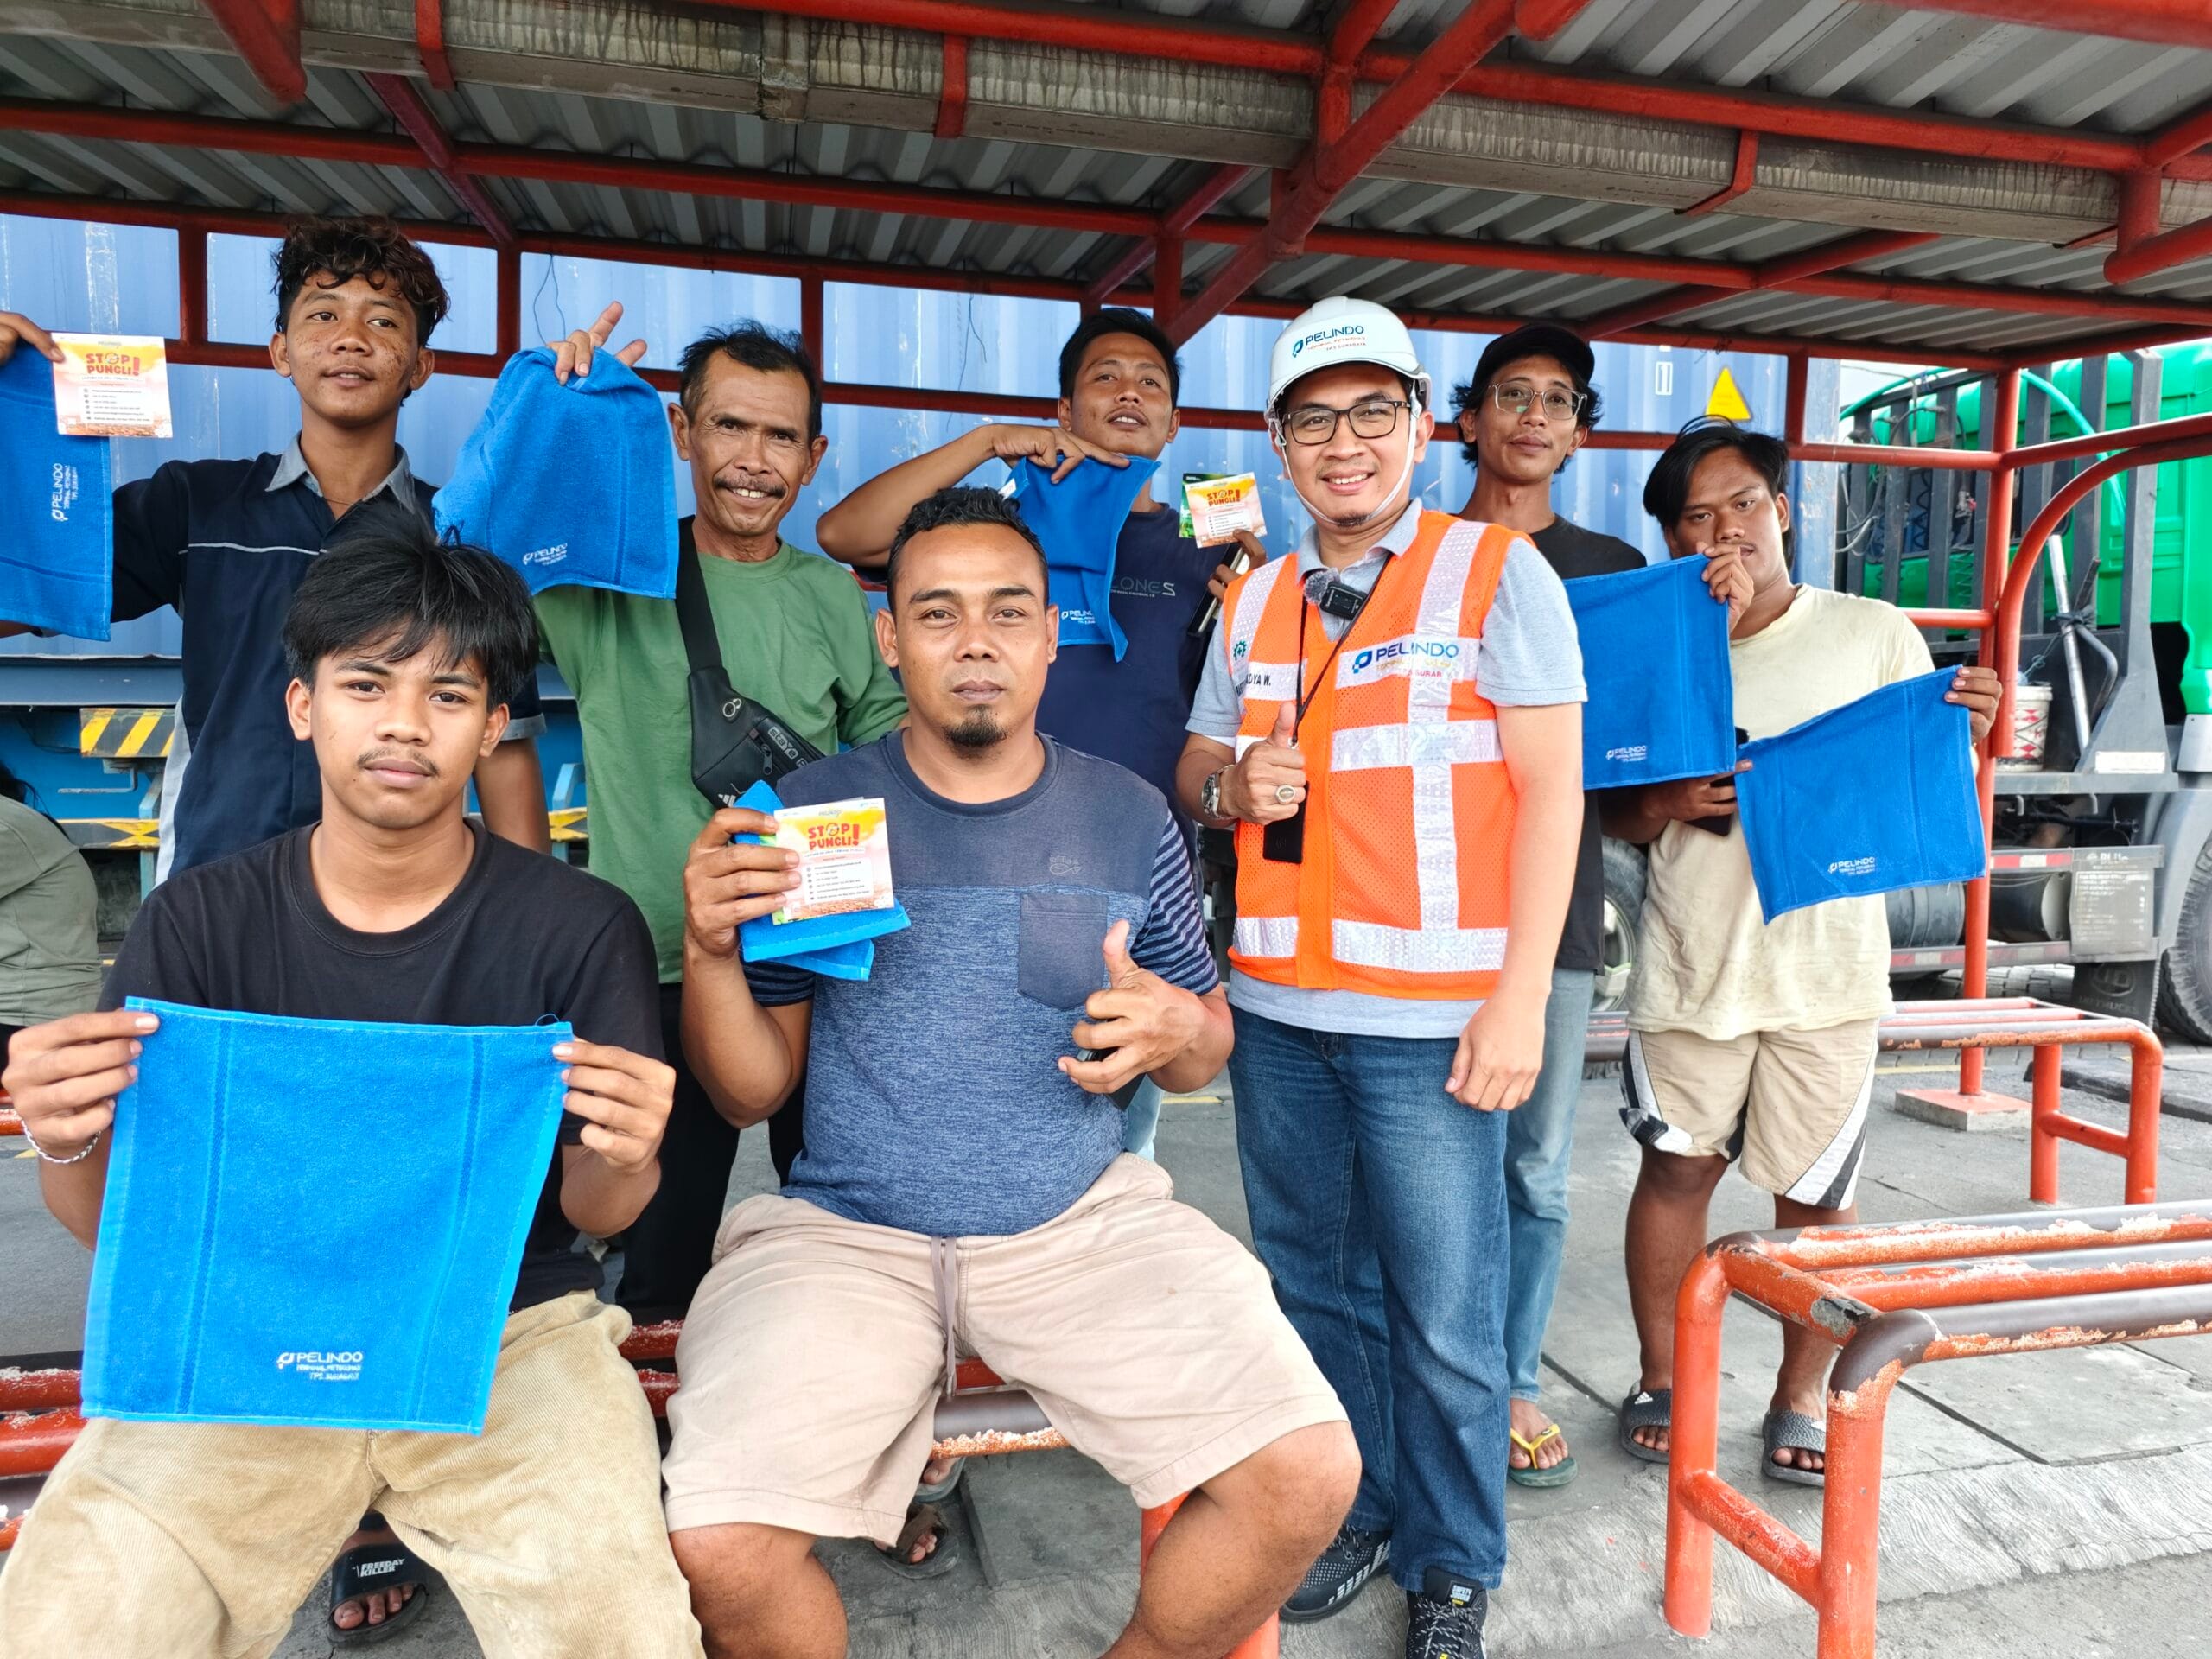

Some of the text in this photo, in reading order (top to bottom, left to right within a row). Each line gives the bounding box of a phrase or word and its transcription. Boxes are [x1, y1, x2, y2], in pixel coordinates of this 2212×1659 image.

[1306, 325, 1365, 346] PELINDO
[86, 352, 131, 365] STOP
[52, 463, 63, 508] PELINDO
[1207, 490, 1234, 500] STOP
[1376, 642, 1459, 662] PELINDO
[808, 822, 850, 839] STOP
[1838, 856, 1875, 868] PELINDO
[296, 1351, 364, 1363] PELINDO
[361, 1558, 405, 1570] FREEDAY
